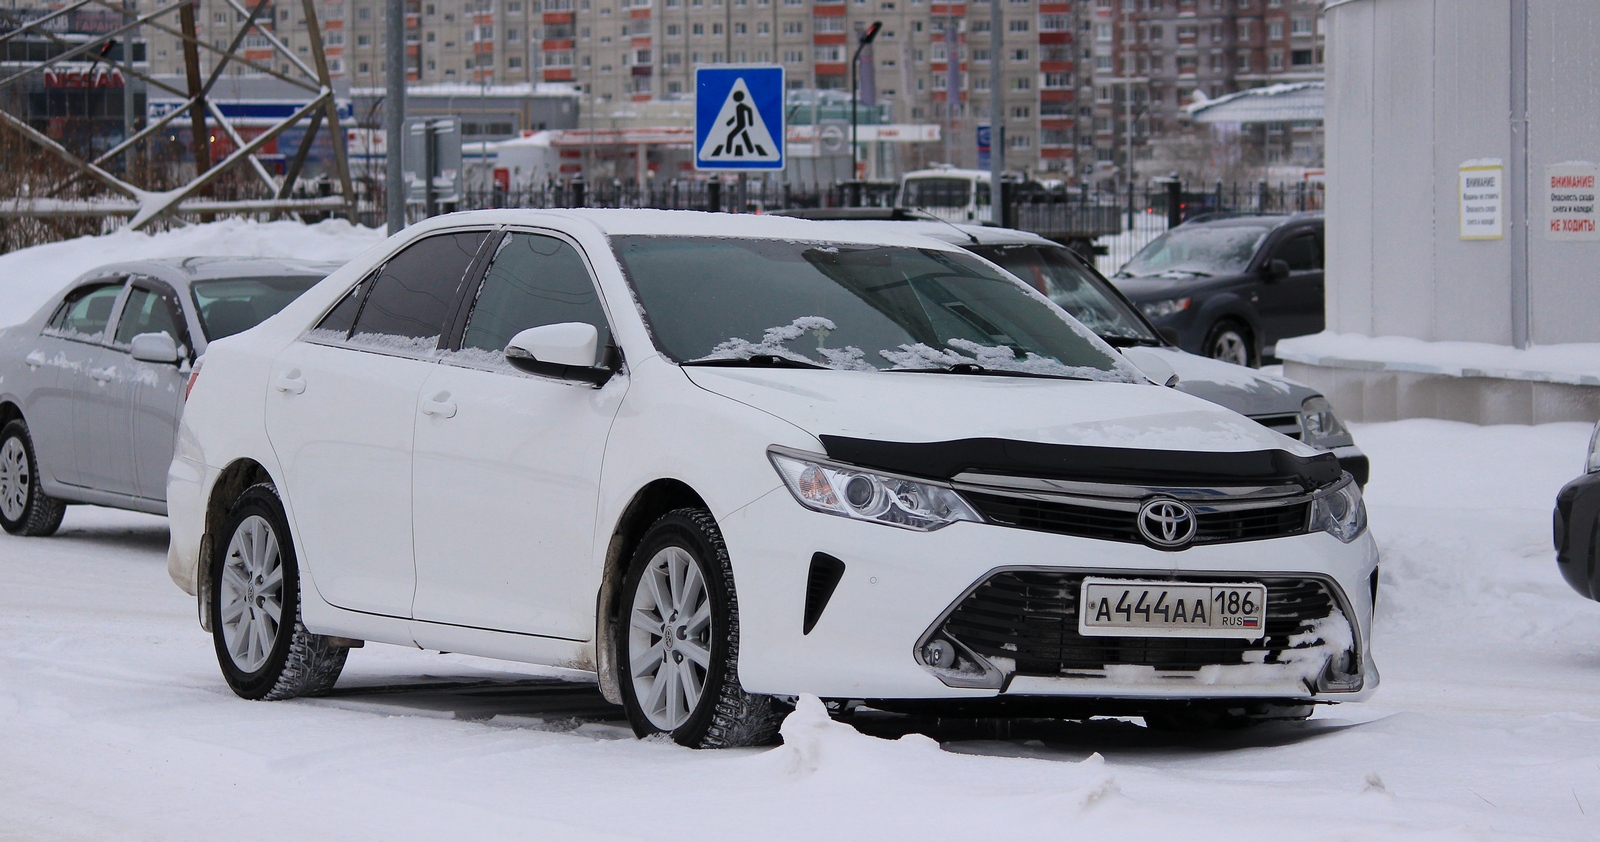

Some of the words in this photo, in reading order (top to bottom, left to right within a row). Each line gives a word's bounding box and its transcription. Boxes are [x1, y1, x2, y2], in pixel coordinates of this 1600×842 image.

[44, 69, 126, 89] NISSAN
[1551, 176, 1595, 188] ВНИМАНИЕ!
[1551, 220, 1561, 231] НЕ
[1563, 220, 1595, 231] ХОДИТЬ!
[1214, 590, 1255, 615] 186
[1222, 617, 1243, 626] RUS
